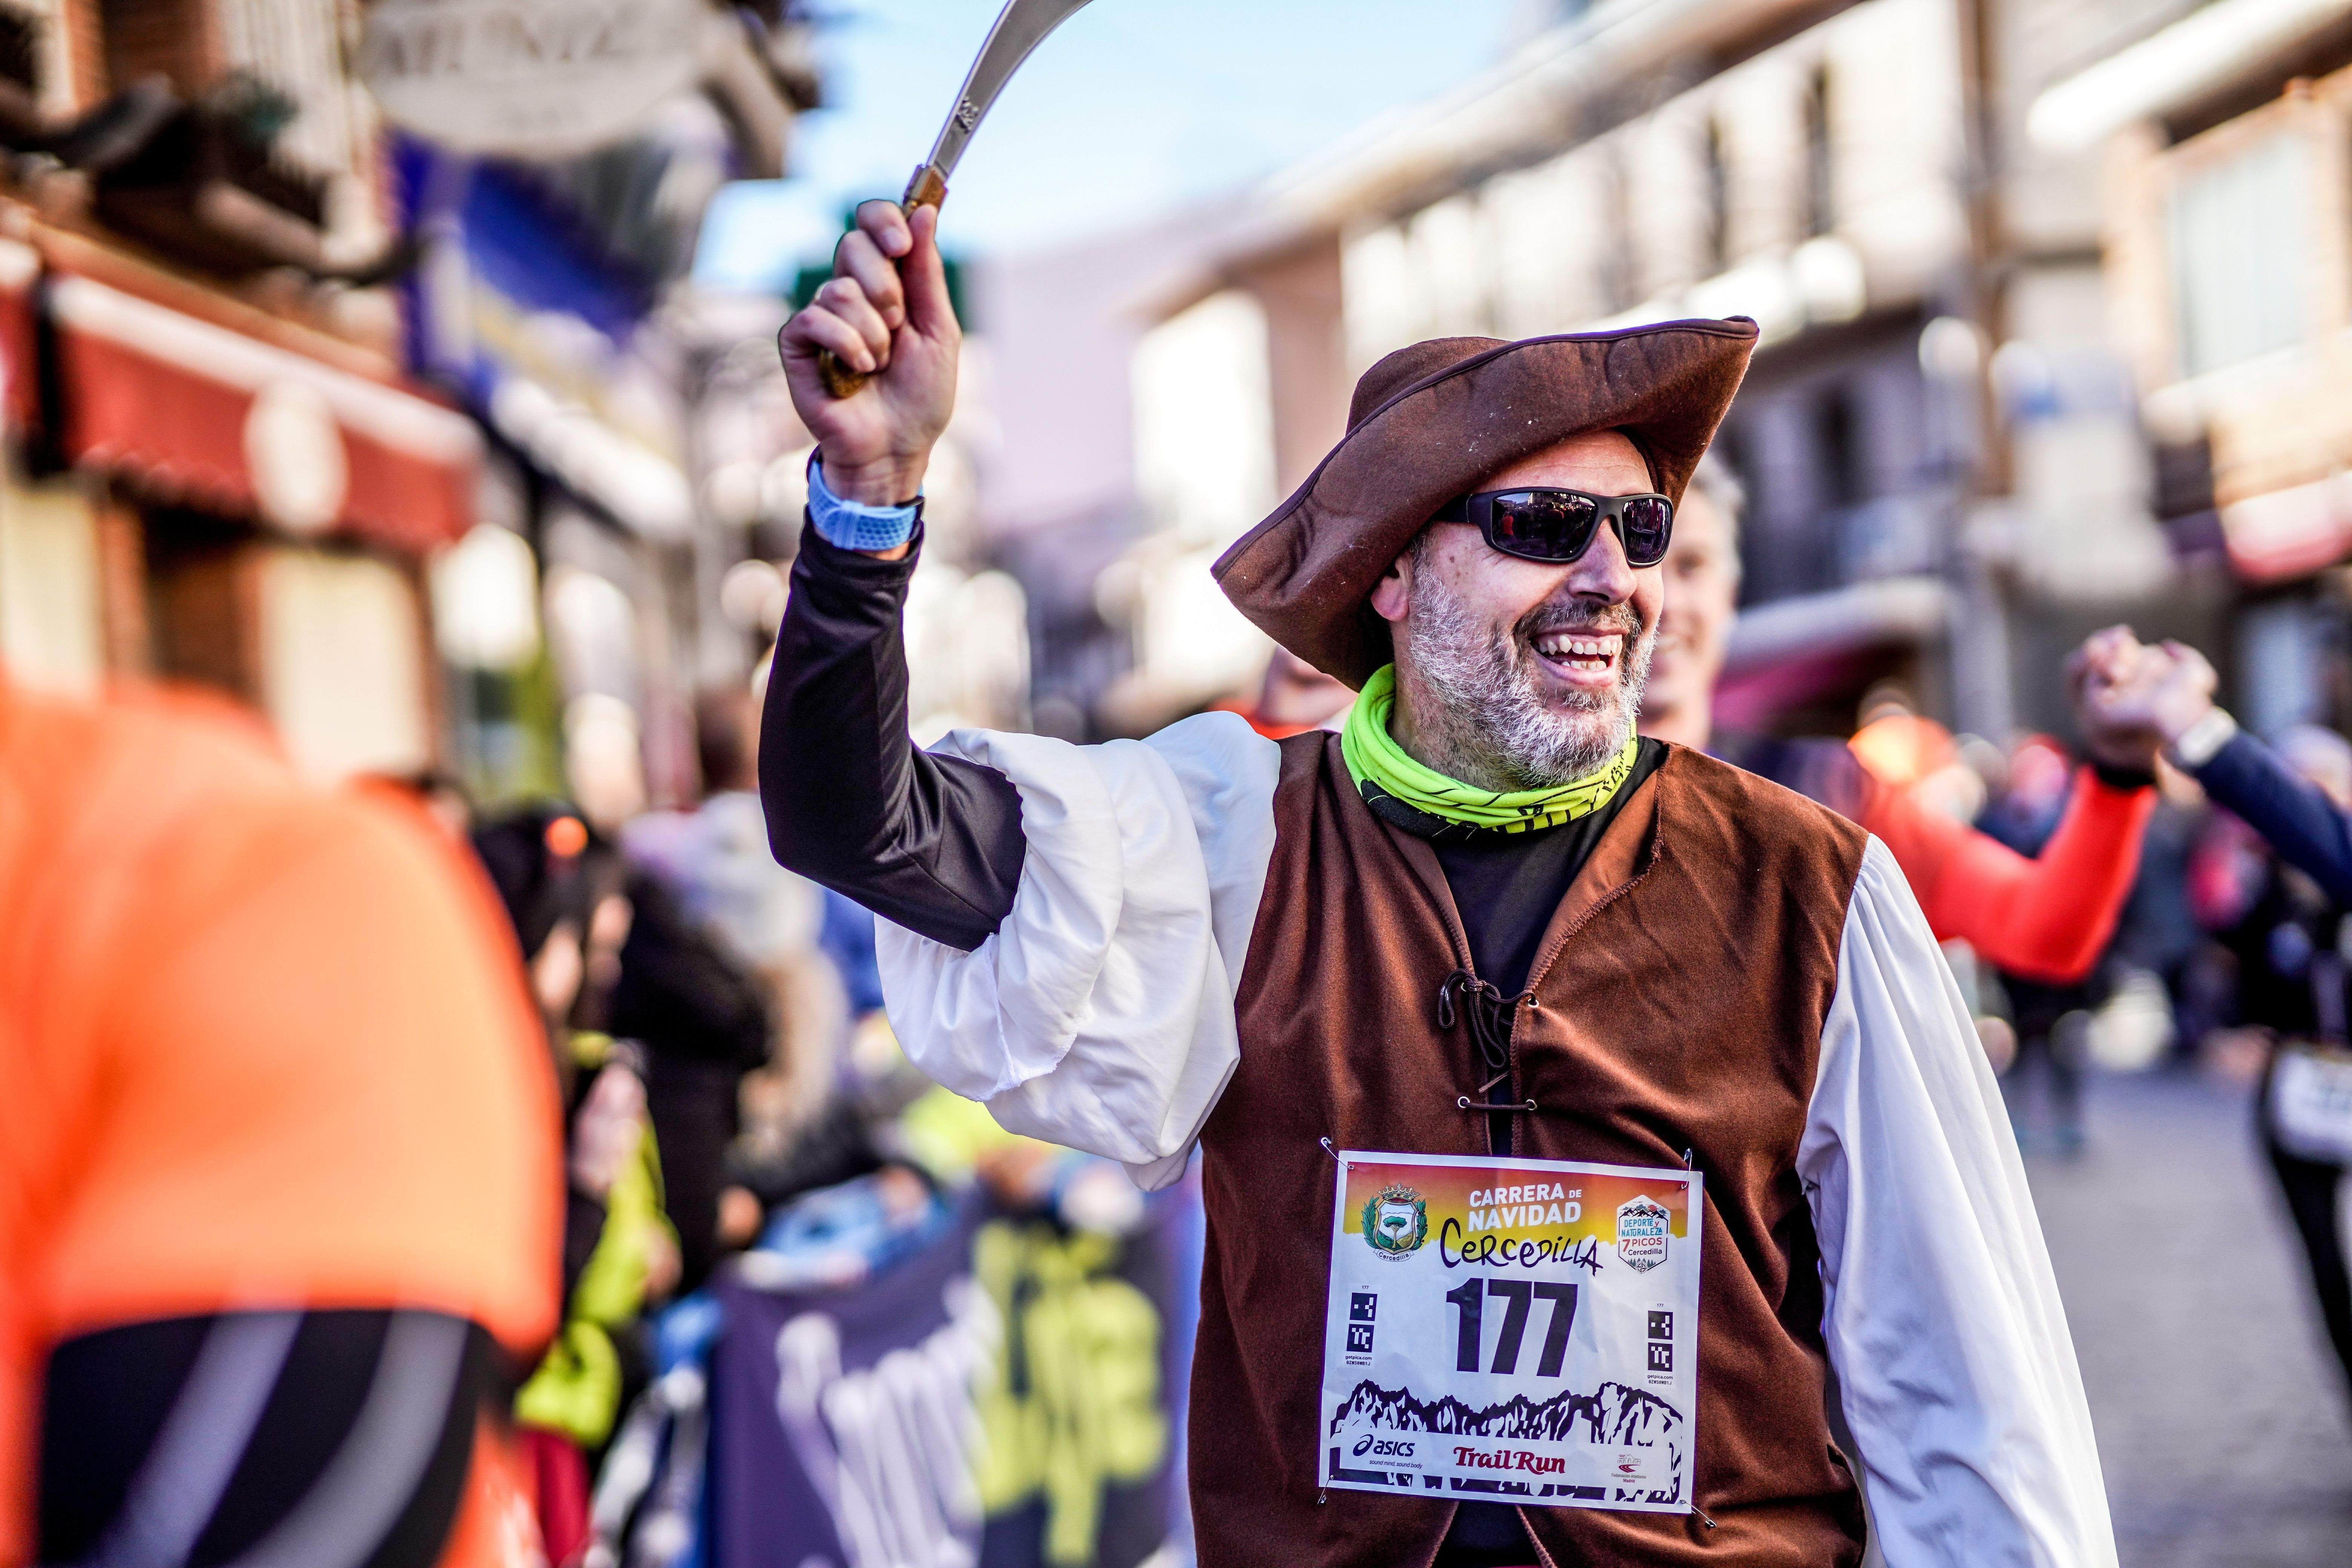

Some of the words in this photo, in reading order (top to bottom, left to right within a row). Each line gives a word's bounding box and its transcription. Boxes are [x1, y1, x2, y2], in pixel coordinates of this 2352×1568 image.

[1470, 1183, 1564, 1207] CARRERA
[1569, 1189, 1582, 1199] DE
[1468, 1202, 1581, 1232] NAVIDAD
[1624, 1219, 1654, 1227] DEPORTE
[1622, 1227, 1663, 1237] NATURALEZA
[1622, 1239, 1631, 1252] 7
[1632, 1237, 1662, 1246] PICOS
[1379, 1252, 1409, 1260] Cercedilla
[1446, 1277, 1578, 1378] 177
